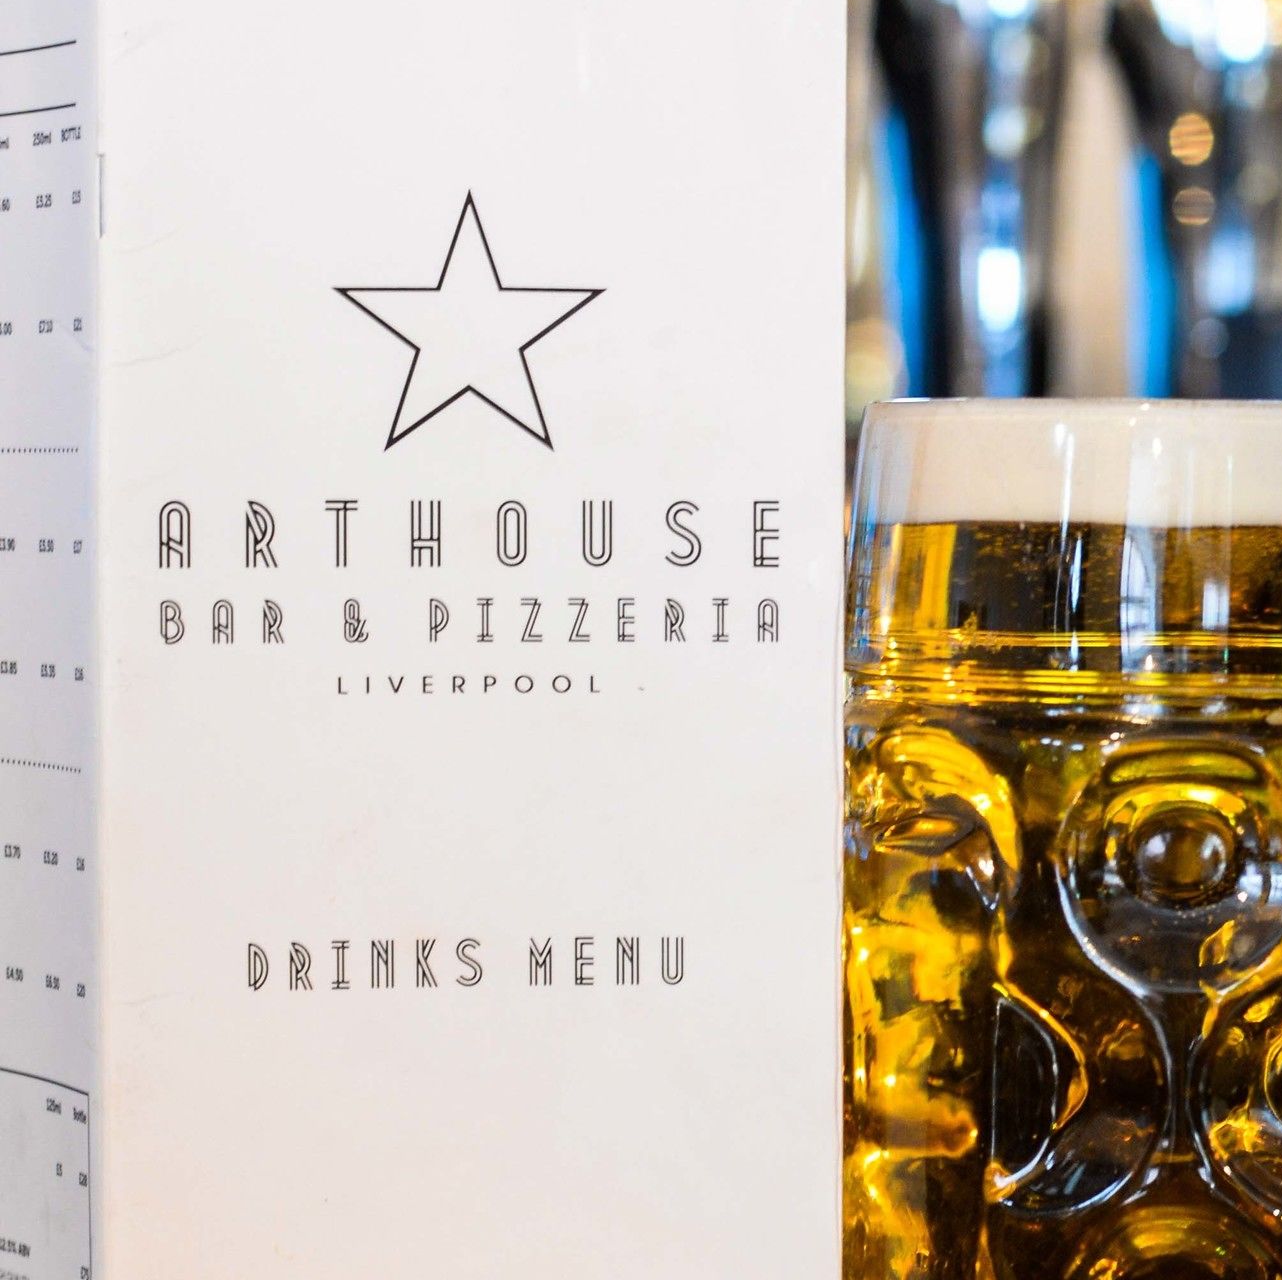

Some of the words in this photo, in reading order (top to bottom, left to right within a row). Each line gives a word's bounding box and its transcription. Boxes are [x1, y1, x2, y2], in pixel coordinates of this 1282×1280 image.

[157, 499, 780, 569] ARTHOUSE
[159, 599, 286, 645] BAR
[342, 598, 370, 644] &
[429, 597, 779, 643] PIZZERIA
[337, 674, 602, 695] LIVERPOOL
[246, 938, 484, 991] DRINKS
[528, 936, 686, 986] MENU
